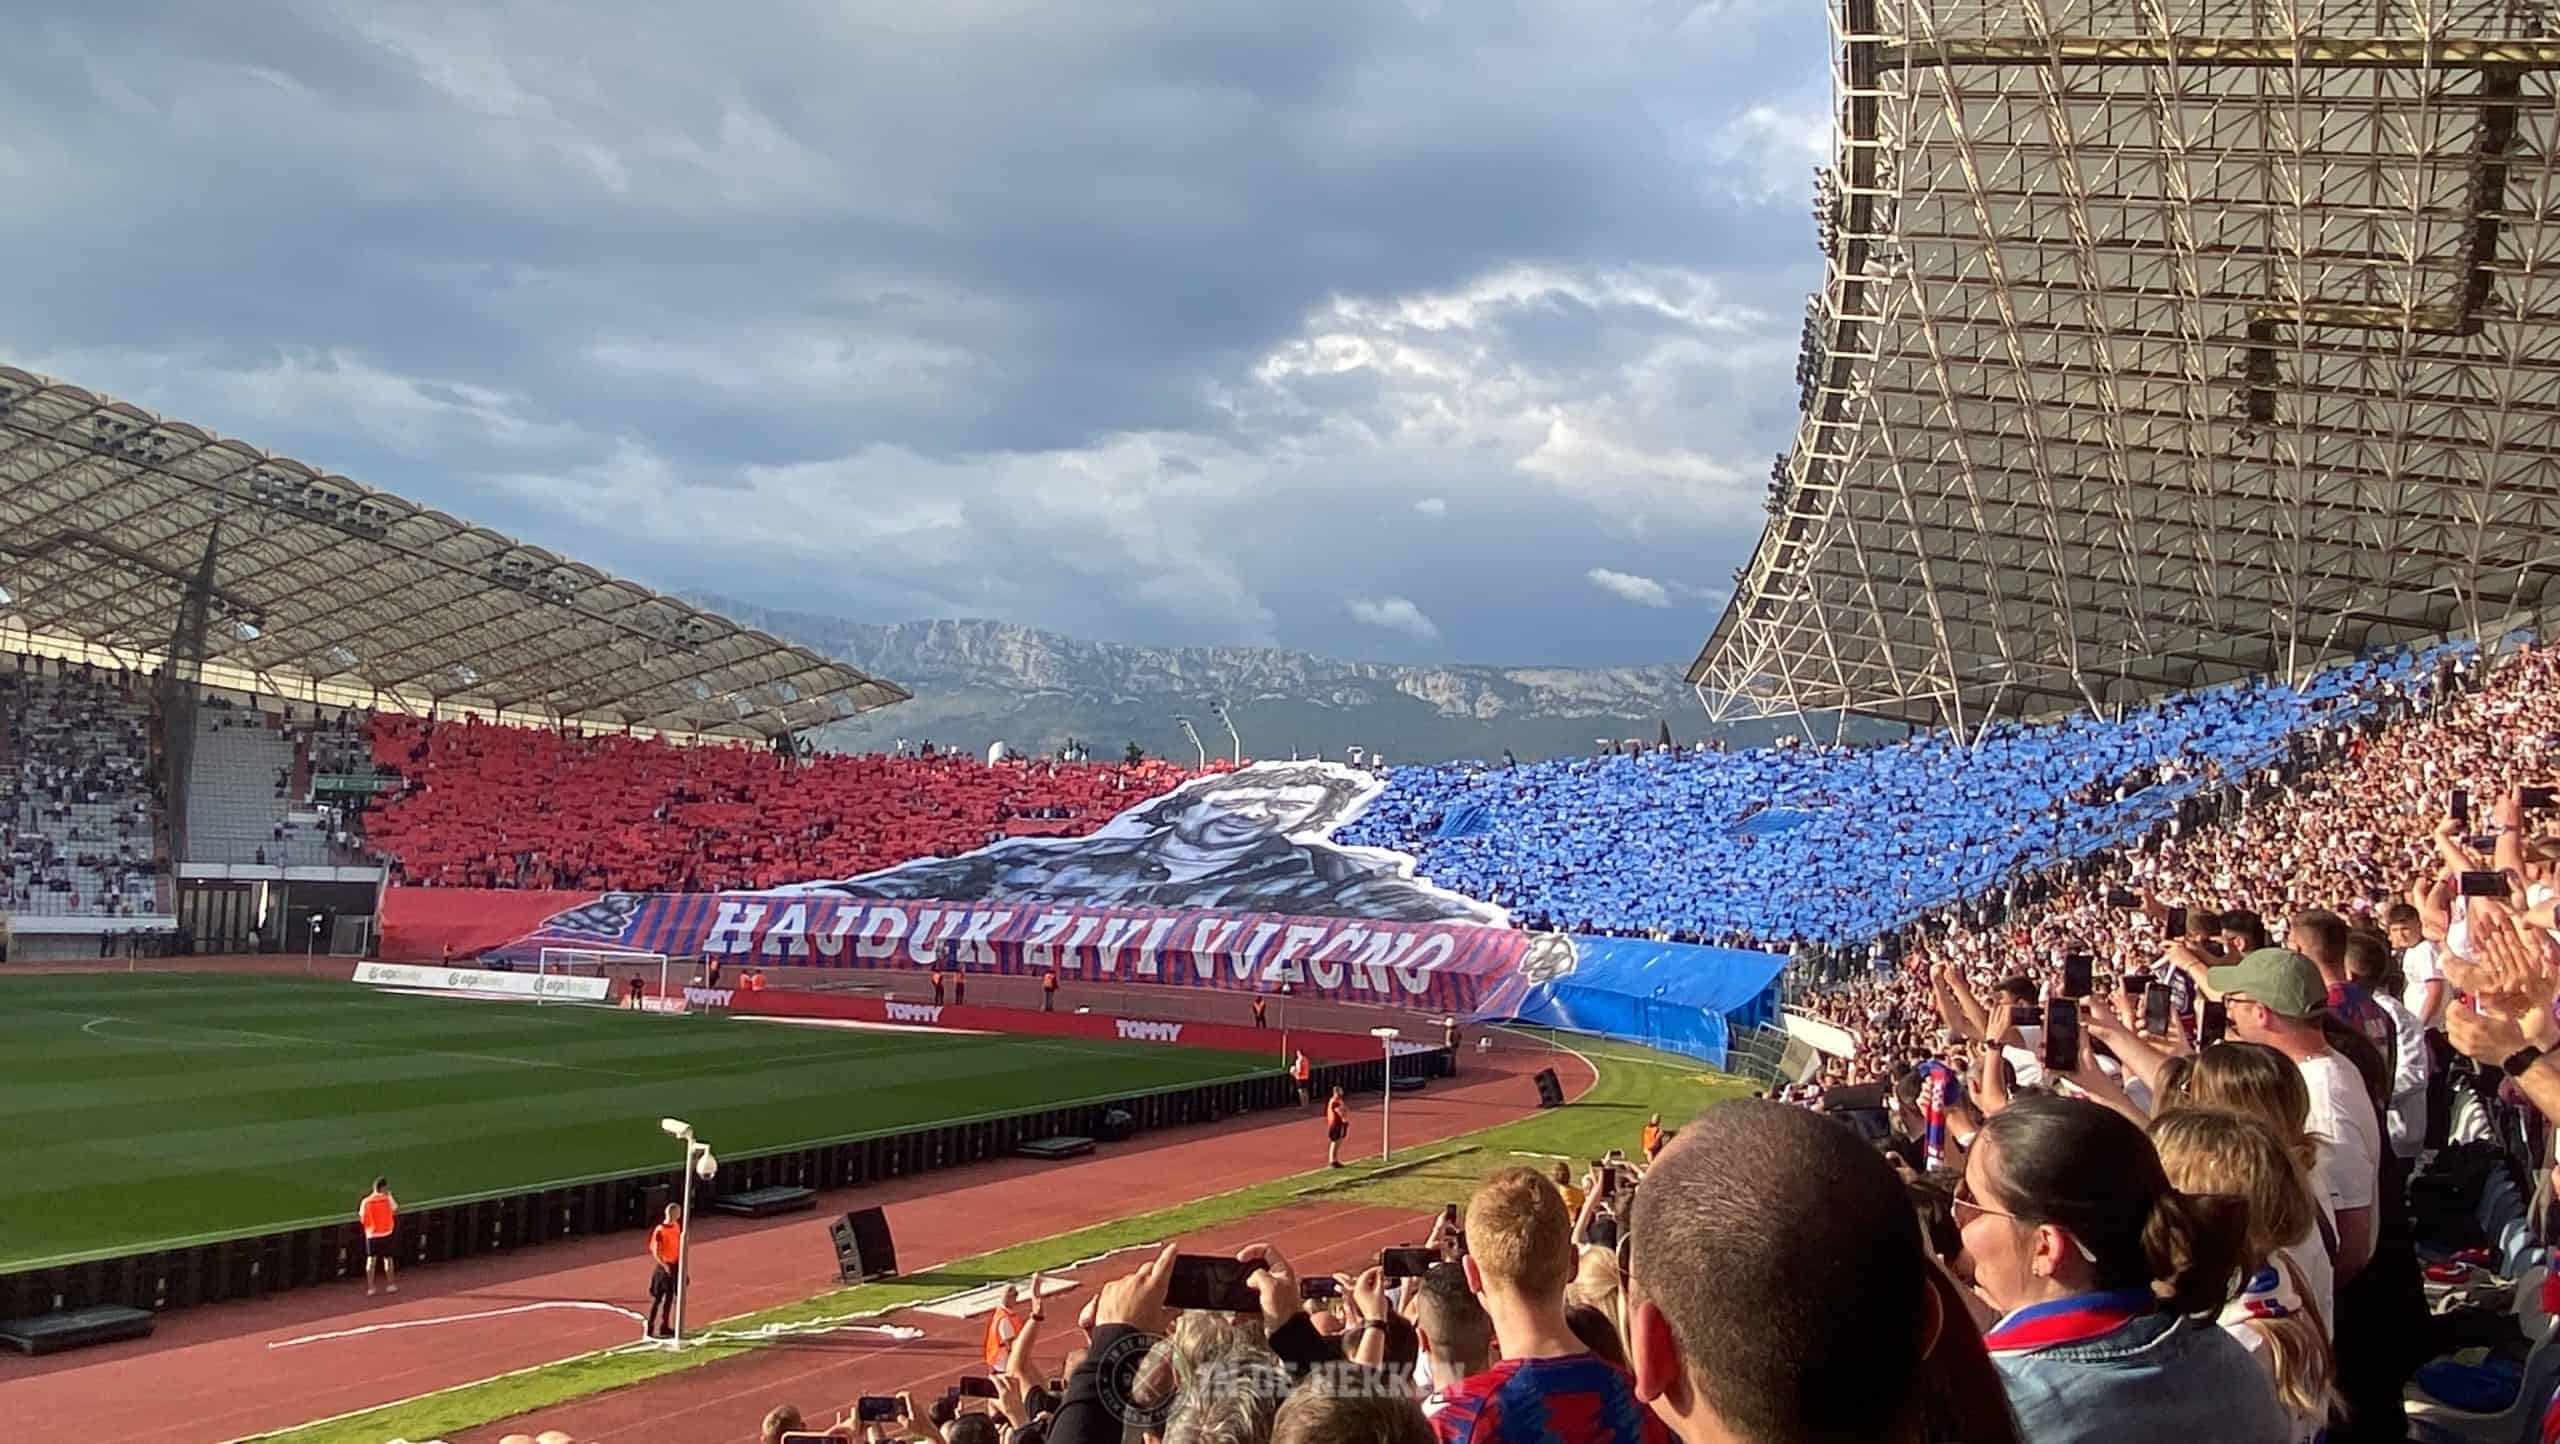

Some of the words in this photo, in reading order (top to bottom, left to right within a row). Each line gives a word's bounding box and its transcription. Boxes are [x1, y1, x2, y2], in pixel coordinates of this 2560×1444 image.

[702, 902, 1012, 965] HAJDUK
[1023, 909, 1176, 975] ŽIVI
[1191, 917, 1457, 993] VJEČNO
[683, 987, 734, 1006] TOMMY
[884, 1002, 945, 1023] TOMMY
[1116, 1018, 1183, 1042] TOMMY
